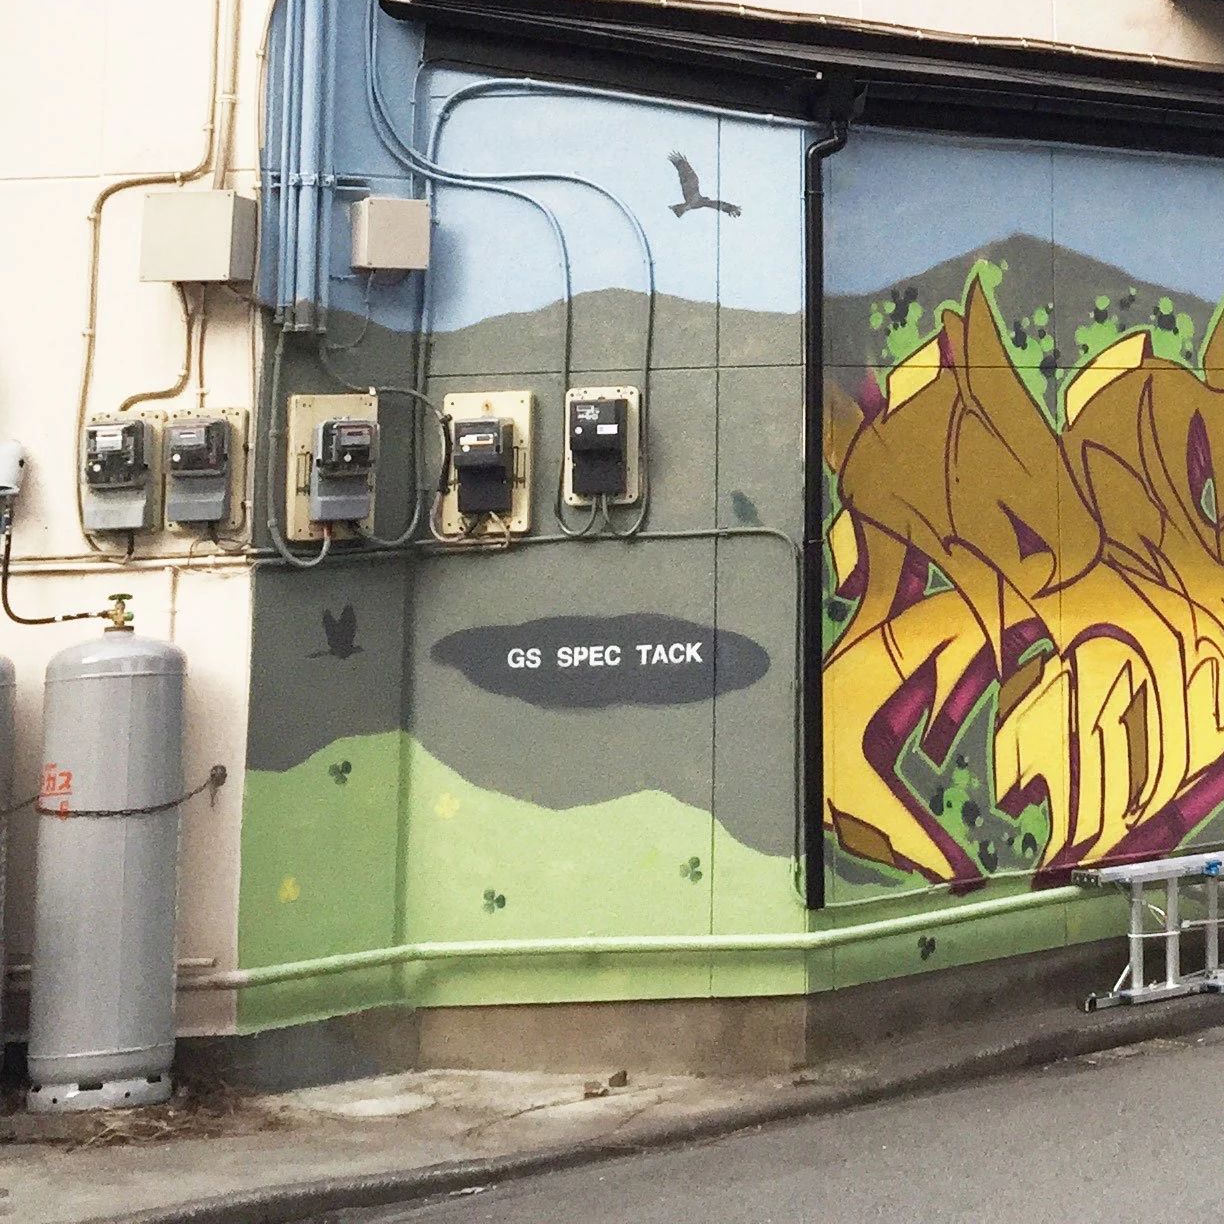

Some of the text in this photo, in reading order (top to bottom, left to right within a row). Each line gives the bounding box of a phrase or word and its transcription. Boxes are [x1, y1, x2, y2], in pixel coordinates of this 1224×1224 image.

[507, 642, 703, 669] GS SPEC TACK
